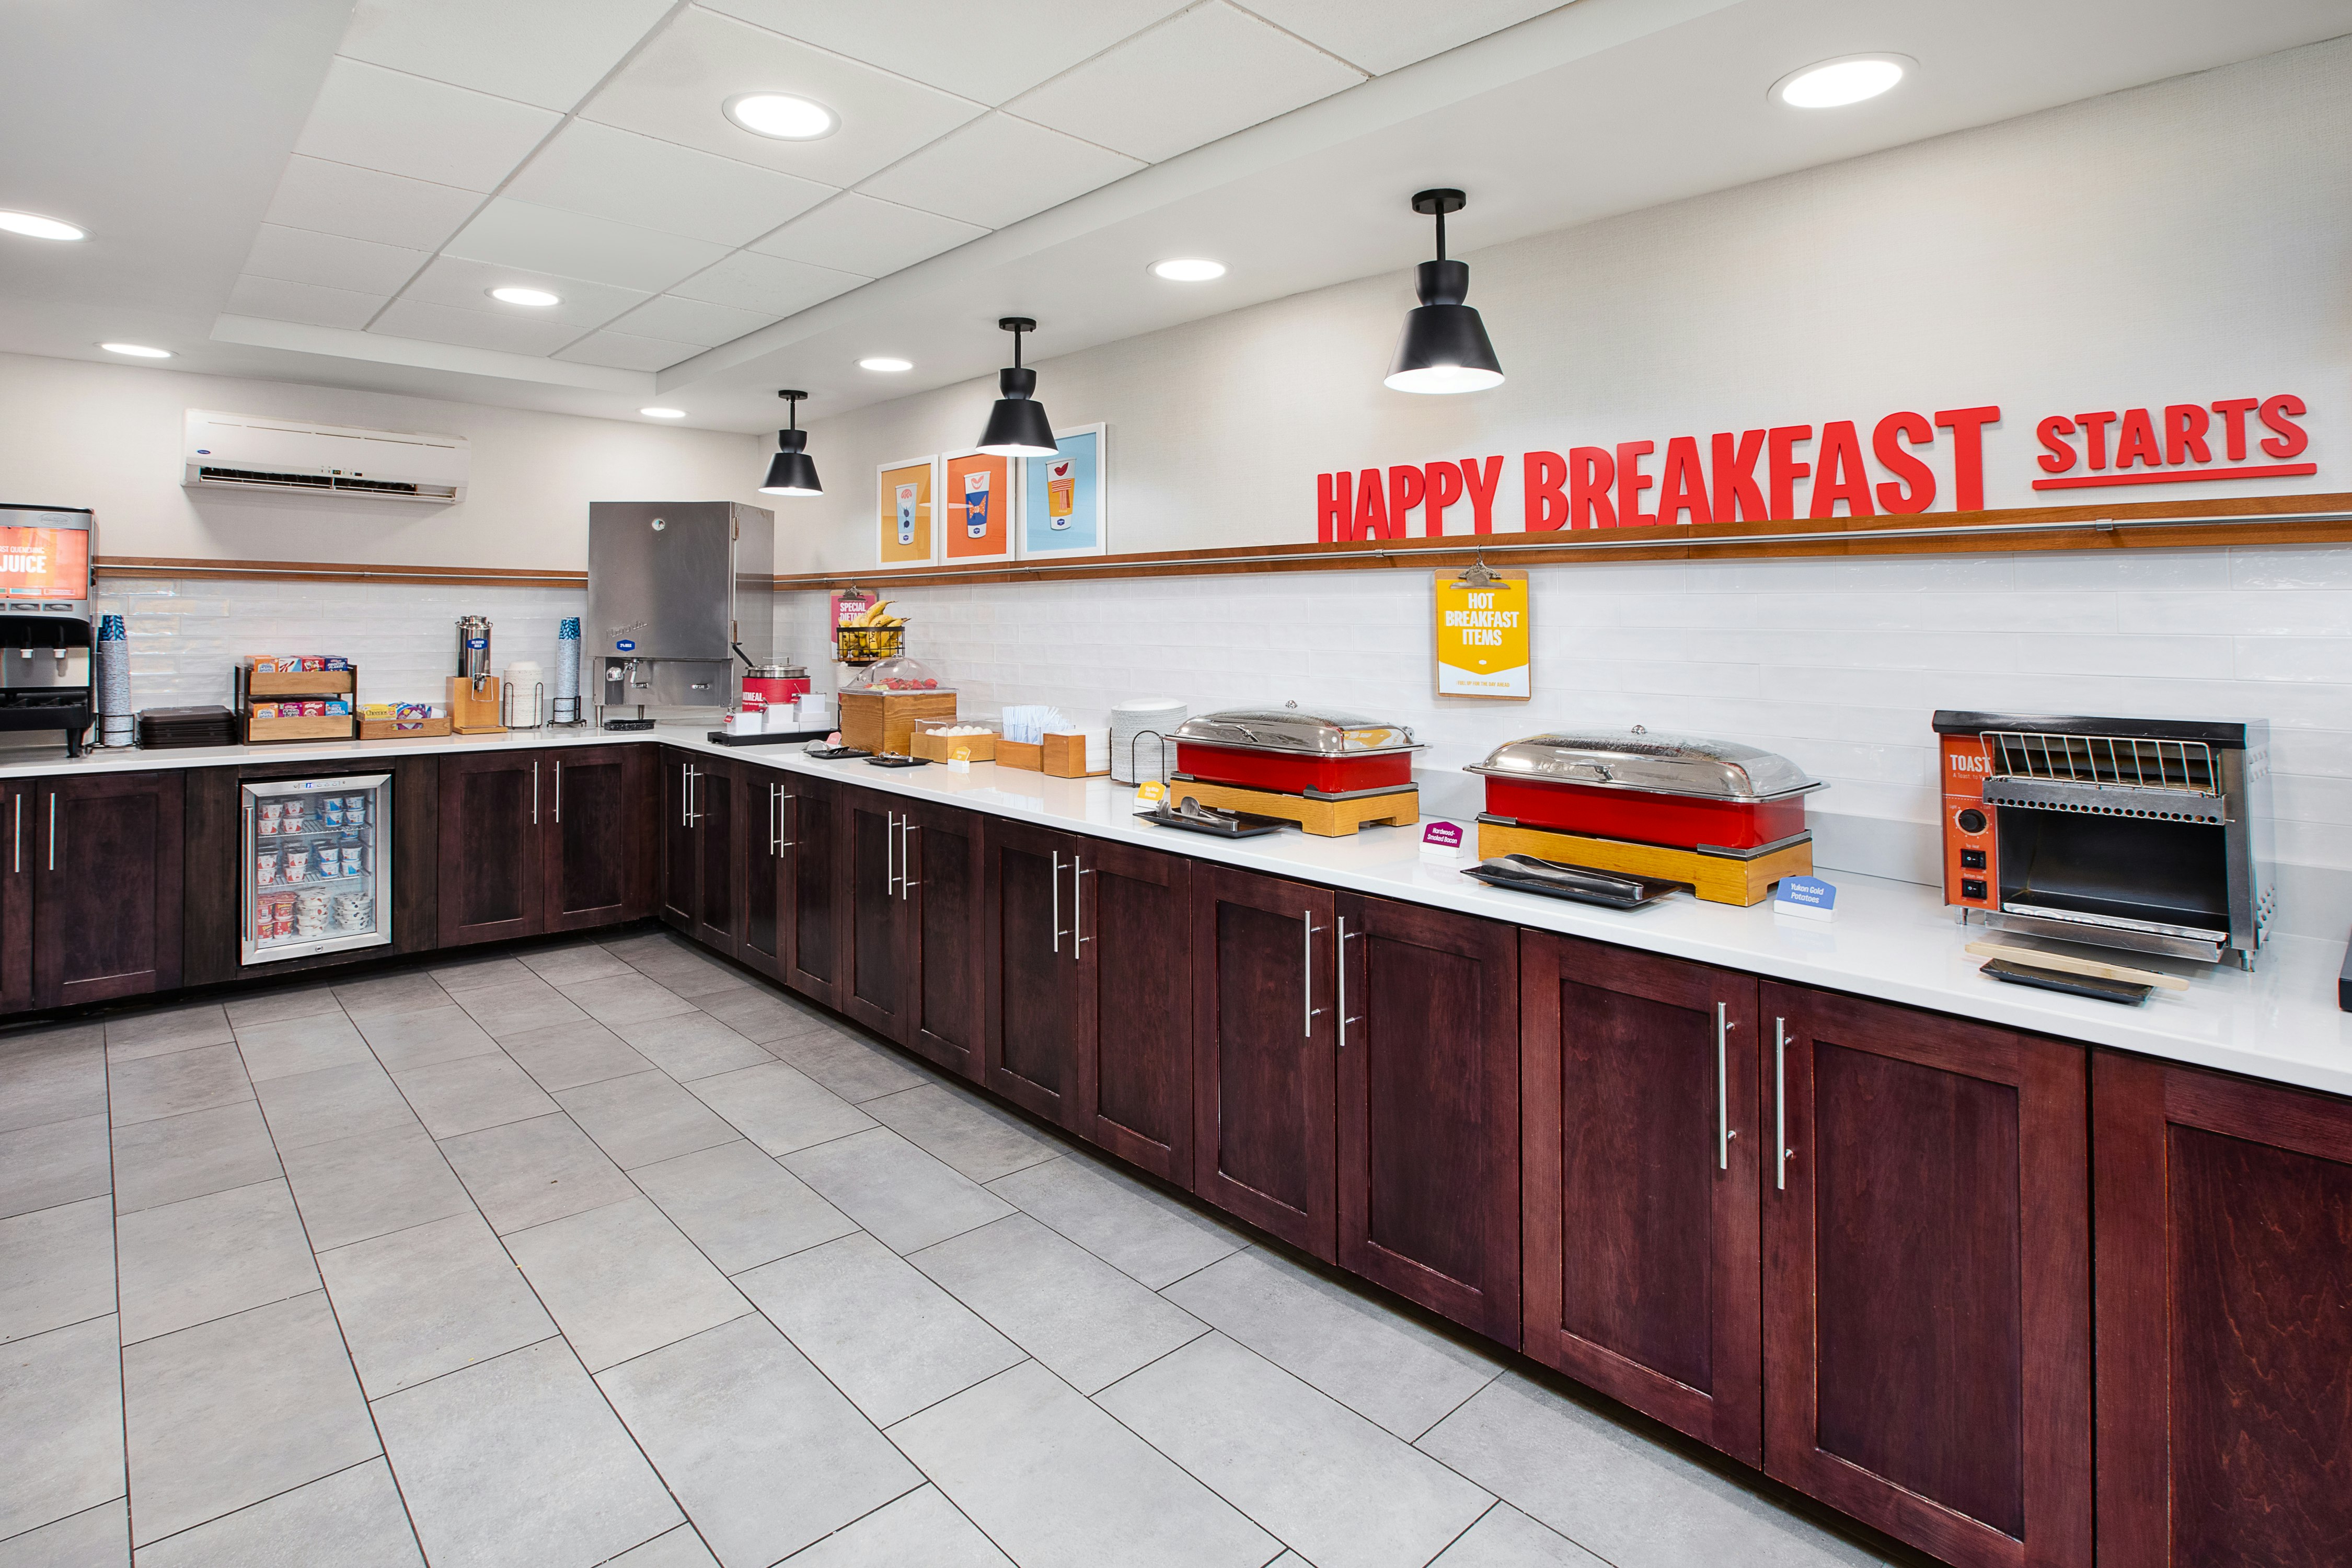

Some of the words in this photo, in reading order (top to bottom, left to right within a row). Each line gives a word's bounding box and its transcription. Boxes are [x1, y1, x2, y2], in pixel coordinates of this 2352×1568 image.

[1318, 455, 1504, 543] HAPPY
[1524, 406, 2001, 533] BREAKFAST
[2036, 394, 2309, 473] STARTS
[0, 555, 47, 573] JUICE
[840, 602, 867, 612] SPECIAL
[1468, 593, 1495, 609] HOT
[1445, 610, 1519, 628] BREAKFAST
[1462, 629, 1502, 646] ITEMS
[1950, 754, 1991, 773] TOAST
[1427, 834, 1444, 842] Smoked
[1432, 827, 1455, 836] Hardwood-
[1791, 883, 1809, 893] Yukon
[1809, 886, 1824, 895] Gold
[1791, 892, 1819, 903] Potatoes
